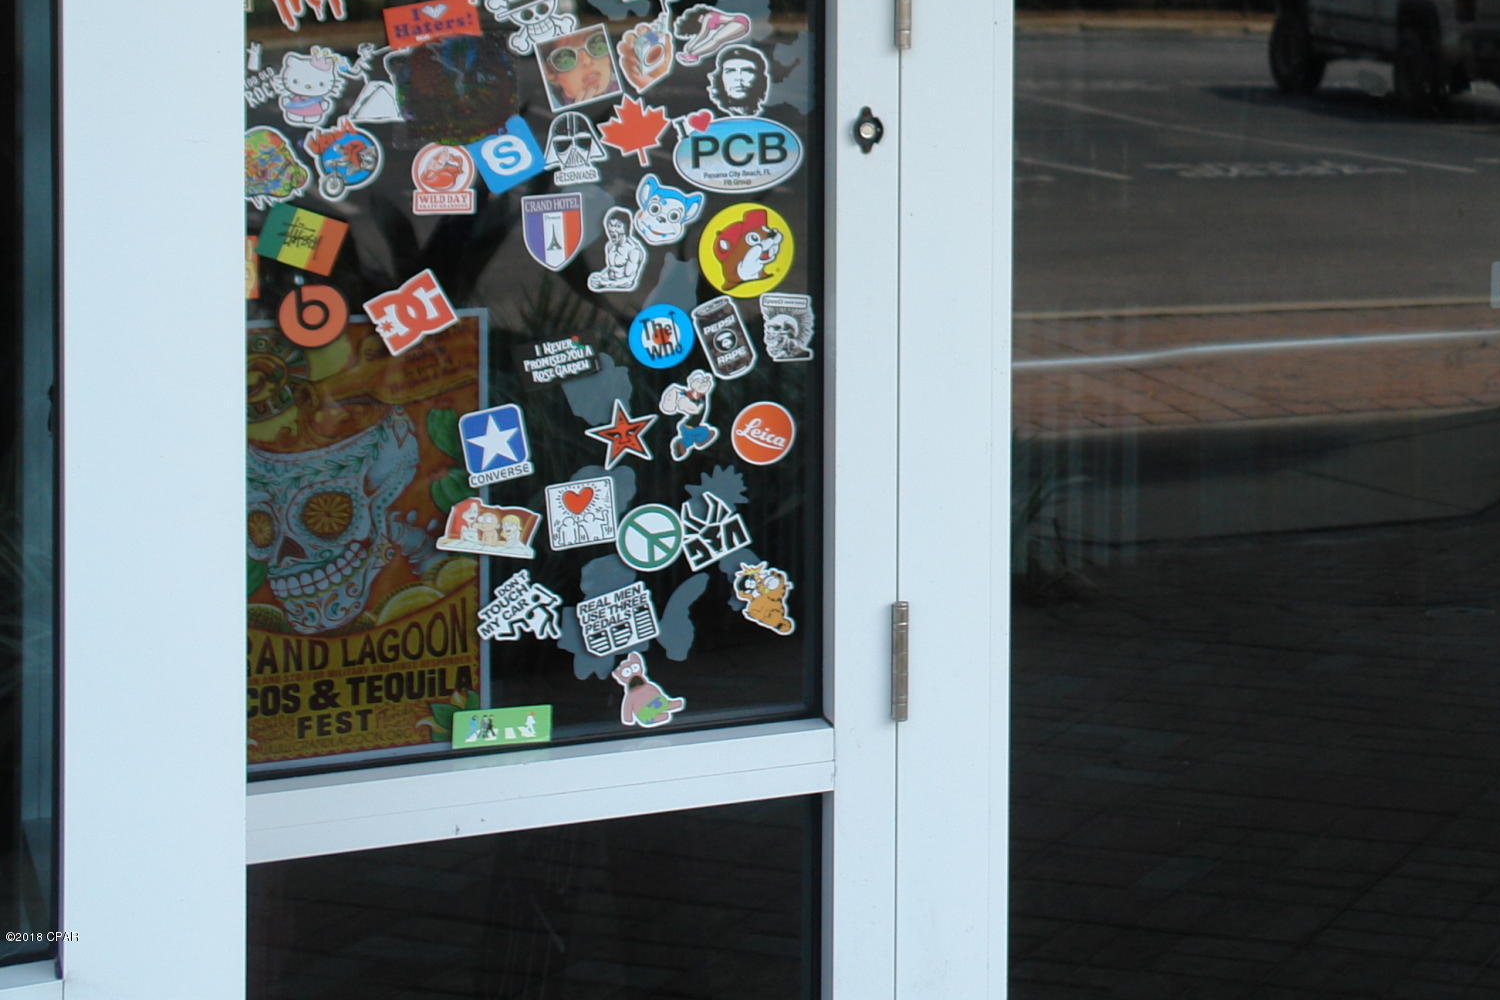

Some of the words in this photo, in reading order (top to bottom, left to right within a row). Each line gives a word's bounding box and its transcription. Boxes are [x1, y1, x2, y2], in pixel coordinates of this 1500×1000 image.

[394, 12, 473, 38] Haters!
[690, 131, 788, 169] PCB
[553, 197, 580, 211] HOTEL
[639, 317, 674, 342] The
[703, 314, 736, 336] PEPSI
[543, 339, 575, 355] NEVER
[523, 354, 567, 373] PROMISED
[566, 351, 584, 364] YOU
[532, 368, 556, 383] ROSE
[554, 359, 590, 379] GARDEN
[736, 417, 788, 450] Leica
[470, 463, 531, 487] CONVERSE
[480, 585, 529, 619] TOUCH
[578, 596, 611, 615] REAL
[613, 584, 643, 602] MEN
[581, 609, 608, 626] USE
[607, 592, 649, 617] THREE
[480, 617, 501, 637] MY
[502, 598, 528, 622] CAR
[585, 609, 632, 634] PEDALS
[340, 596, 469, 668] LAGOON
[308, 679, 341, 711] &
[297, 708, 374, 740] FEST
